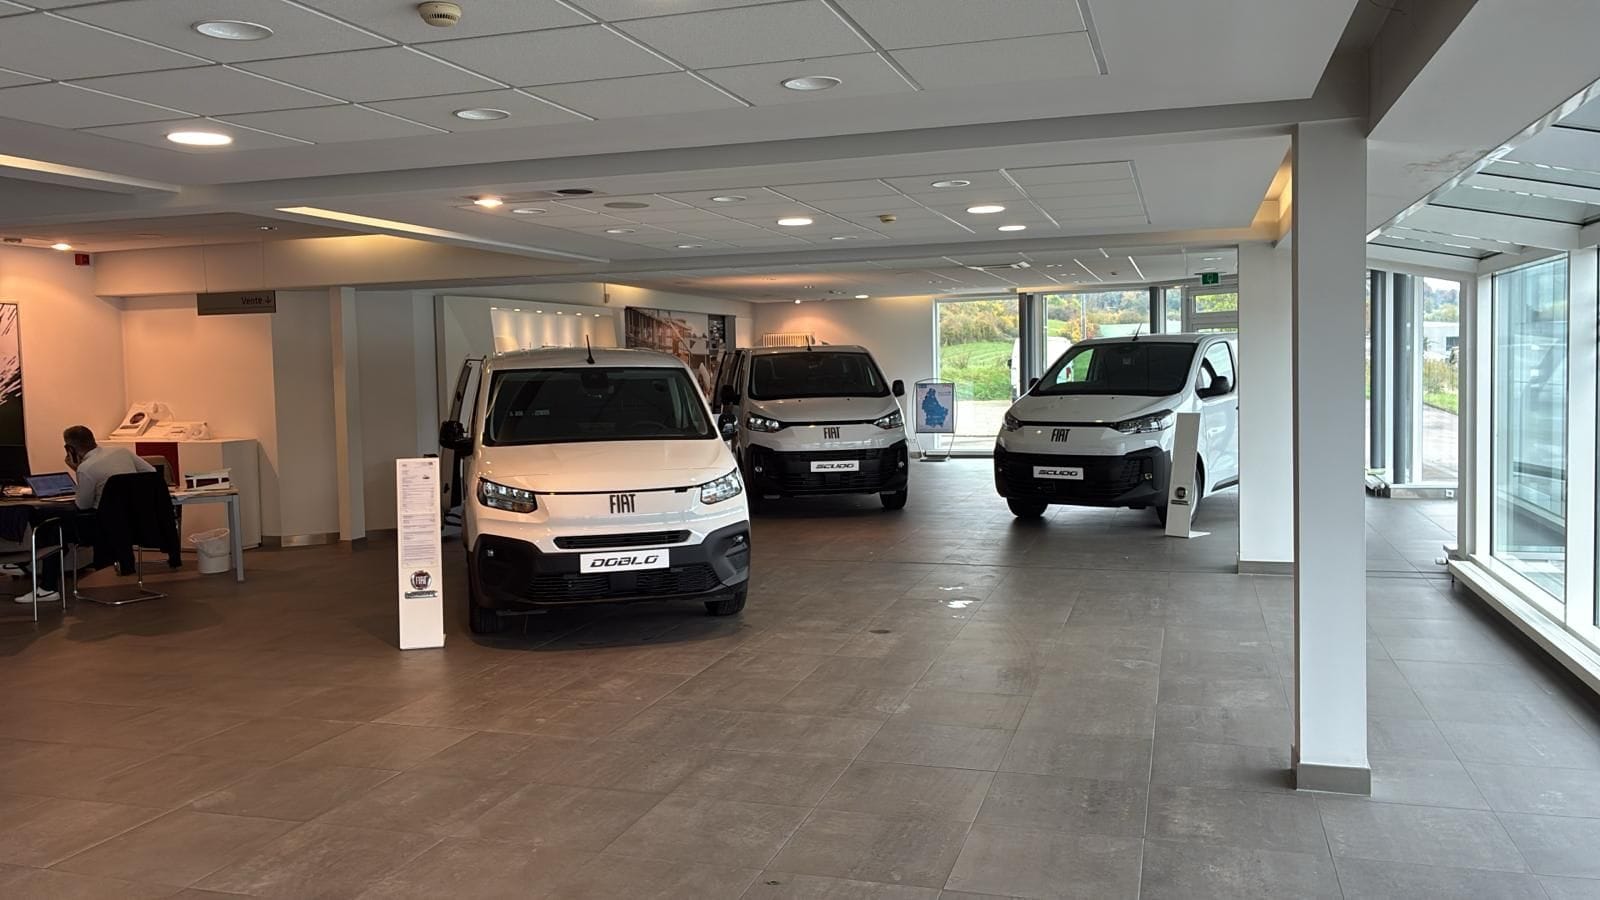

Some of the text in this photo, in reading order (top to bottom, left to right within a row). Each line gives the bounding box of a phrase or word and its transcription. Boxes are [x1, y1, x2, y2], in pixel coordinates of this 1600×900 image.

[241, 296, 263, 305] Vente
[823, 426, 840, 439] FIAT
[1051, 428, 1071, 442] FIAT
[1038, 469, 1078, 477] SCUDO
[609, 493, 636, 514] FIAT
